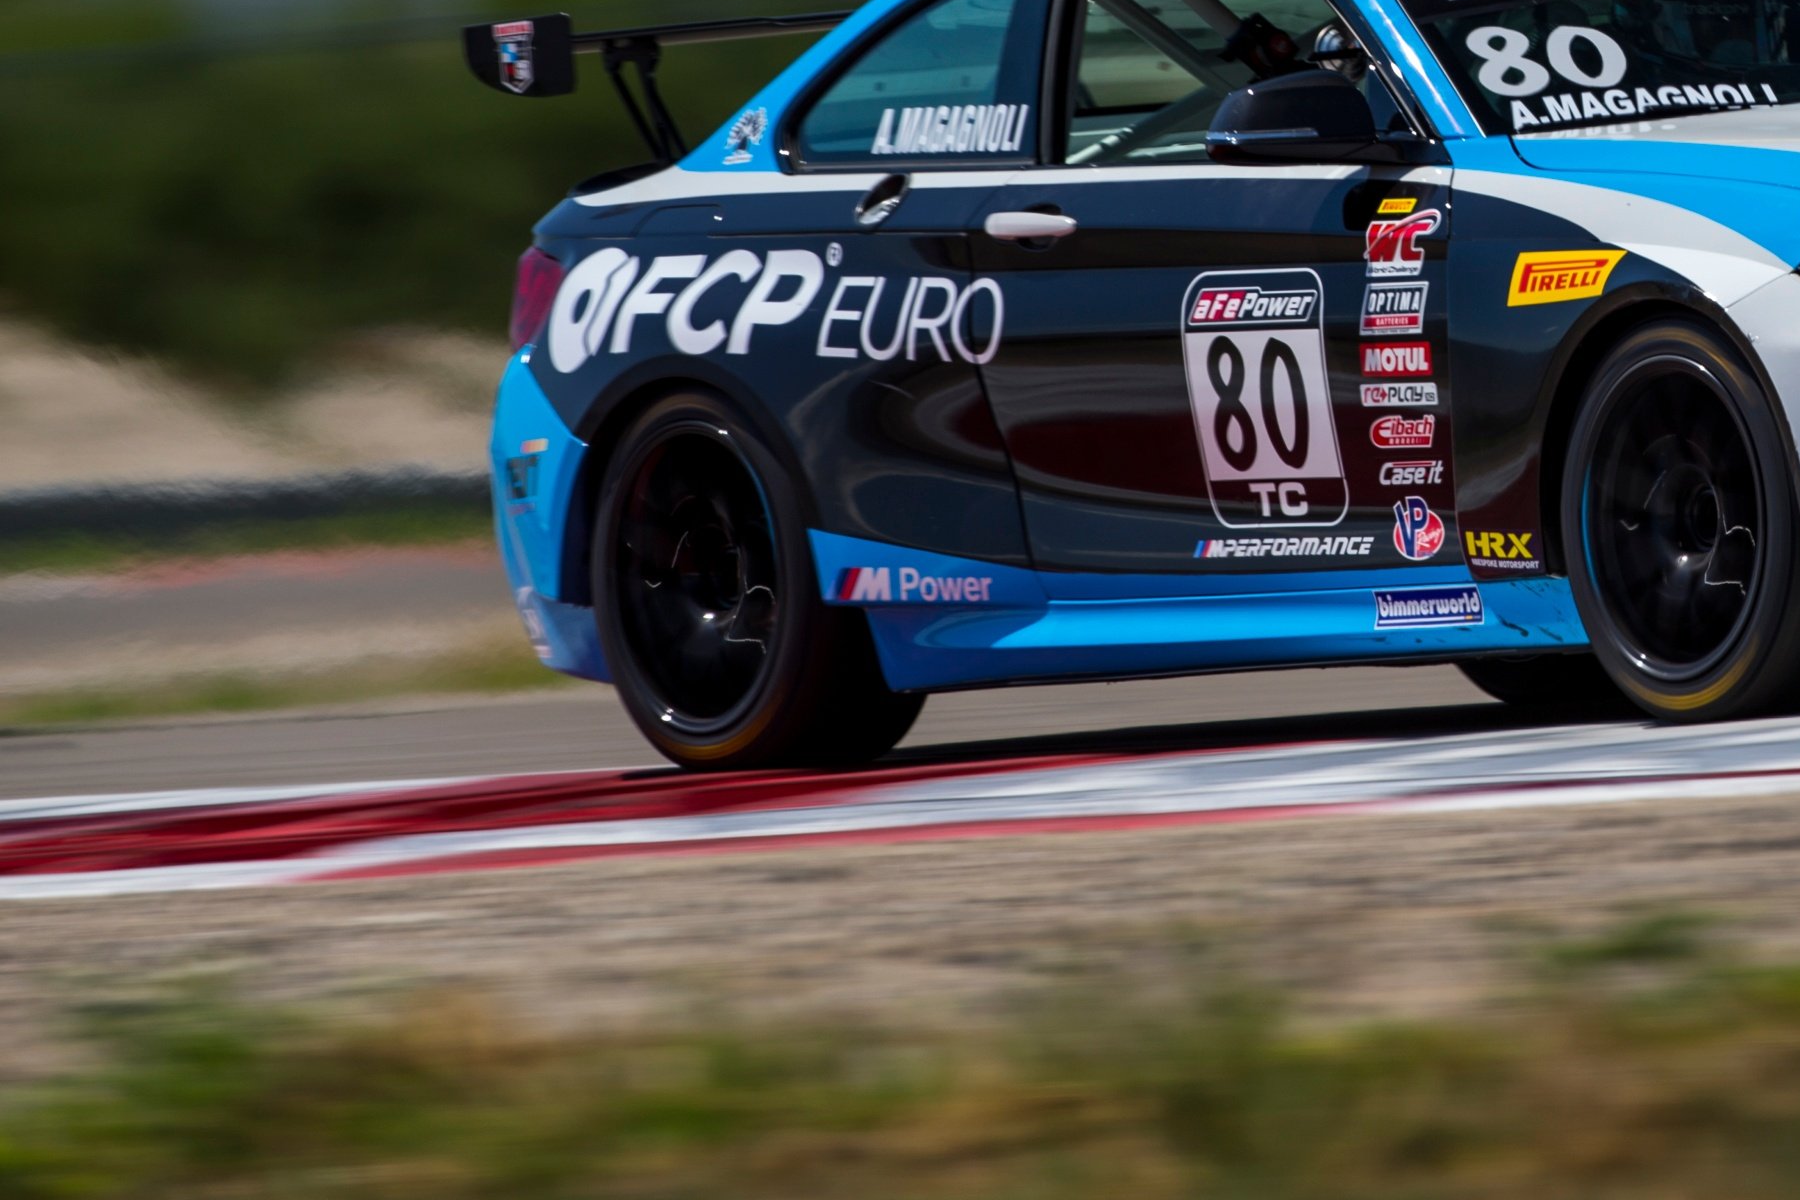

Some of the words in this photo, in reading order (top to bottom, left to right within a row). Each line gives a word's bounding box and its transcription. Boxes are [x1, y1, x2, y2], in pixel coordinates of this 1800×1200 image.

[1465, 25, 1627, 97] 80
[870, 104, 1029, 155] A.MAGAGNOLI
[1518, 259, 1610, 294] PIRELLI
[1367, 291, 1421, 313] OPTIMA
[816, 276, 1005, 365] EURO
[1375, 316, 1409, 326] BATTERIES
[1364, 347, 1429, 373] MOTUL
[1206, 335, 1310, 472] 80
[1372, 416, 1433, 447] Eibach
[1247, 481, 1309, 518] TC
[1392, 496, 1429, 560] VP
[1465, 531, 1534, 559] HRX
[899, 566, 993, 602] Power
[1378, 591, 1481, 618] bimmerworld
